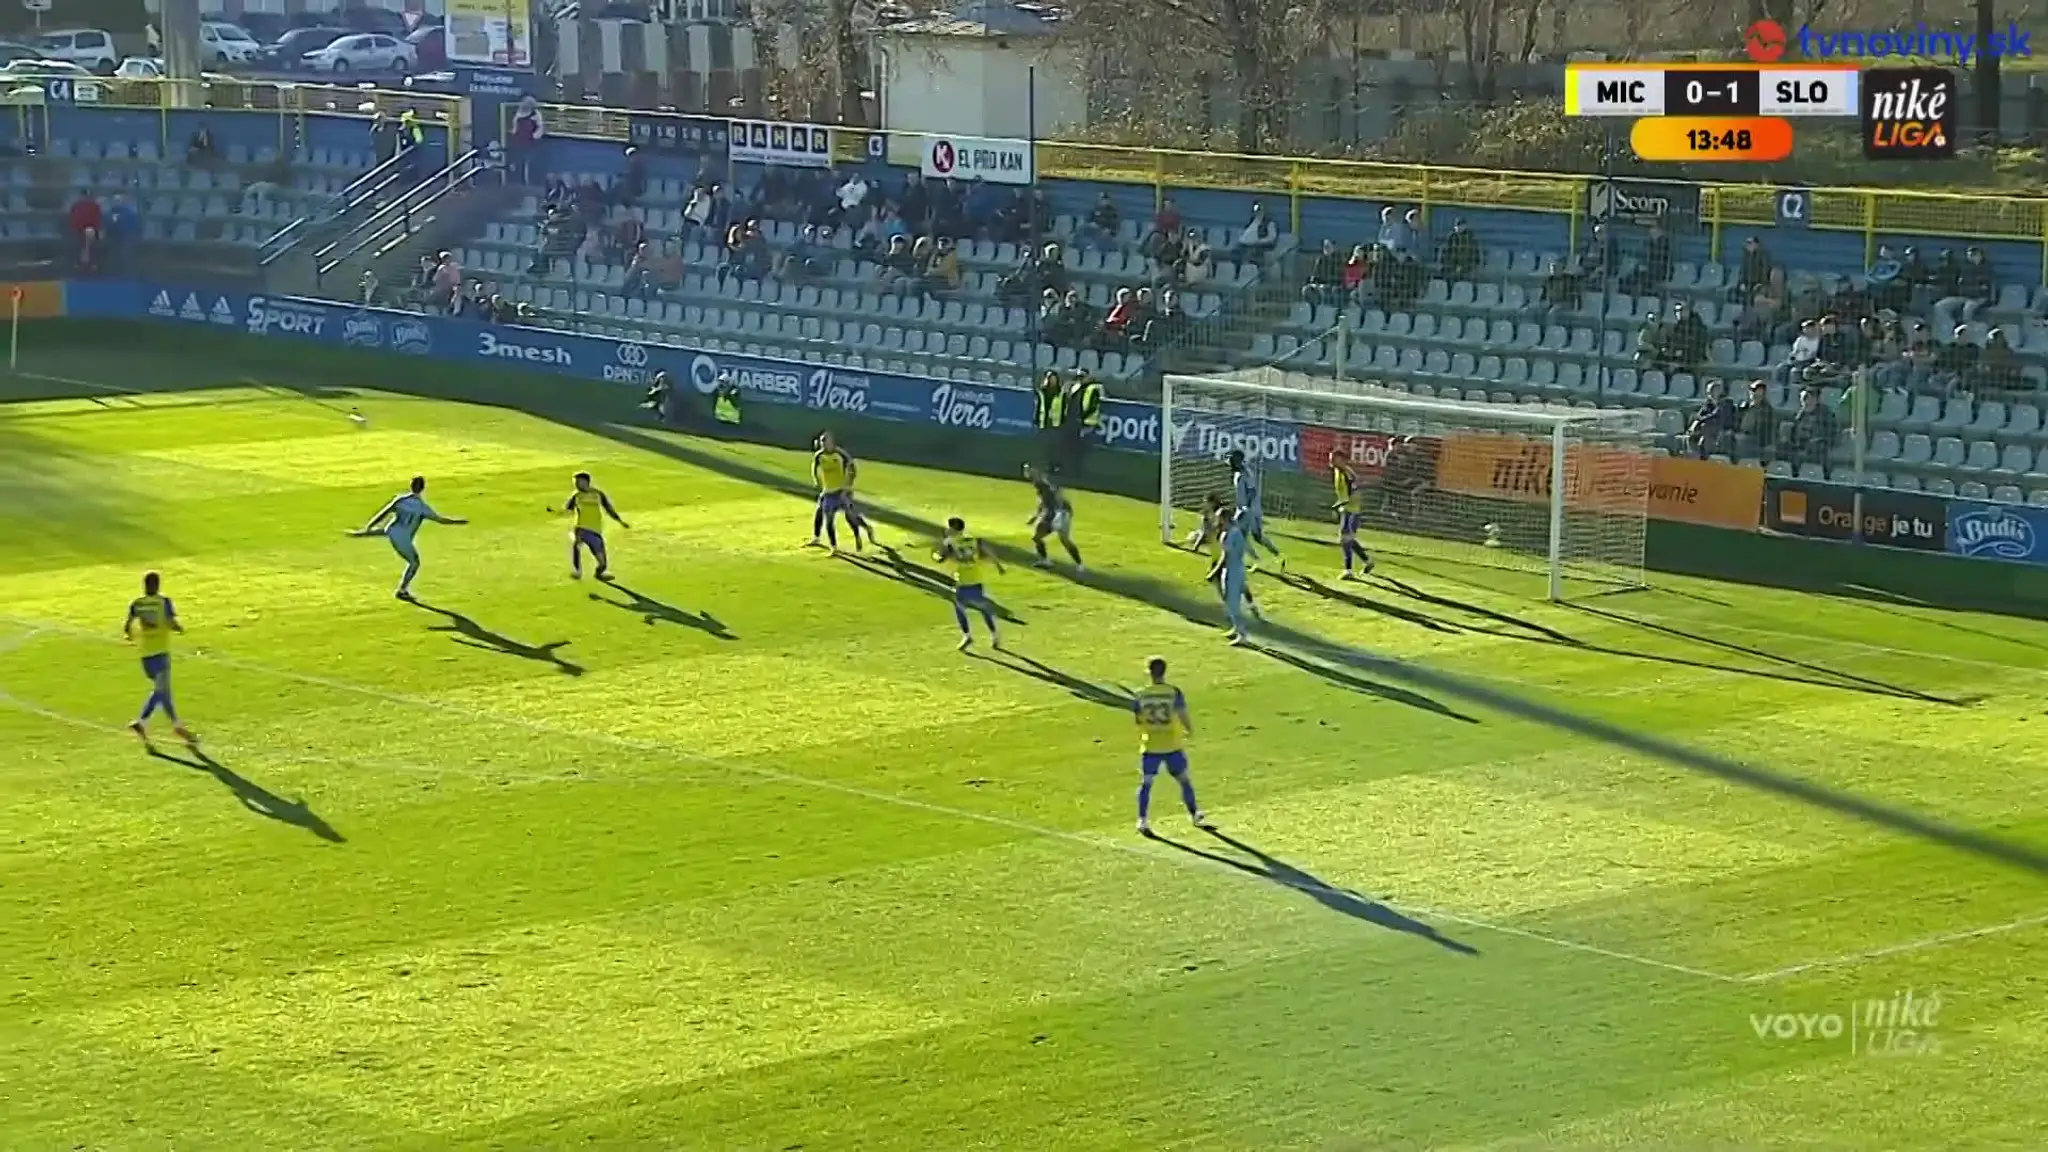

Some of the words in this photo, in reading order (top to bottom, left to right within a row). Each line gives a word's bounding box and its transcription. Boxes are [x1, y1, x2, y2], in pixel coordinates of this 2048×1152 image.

[732, 124, 826, 151] RAHAR
[958, 149, 970, 168] EL
[974, 149, 996, 169] PRO
[1000, 152, 1023, 170] KAN
[1616, 188, 1669, 216] Scorp
[1781, 194, 1803, 218] C2
[478, 332, 573, 366] 3mesh
[719, 368, 800, 397] MARBER
[809, 369, 869, 412] Vera
[931, 383, 994, 429] Vera
[1095, 413, 1159, 444] sport
[1195, 423, 1299, 463] Tipsport
[1818, 505, 1887, 536] Orage
[1890, 513, 1910, 538] je
[1912, 516, 1933, 538] tu
